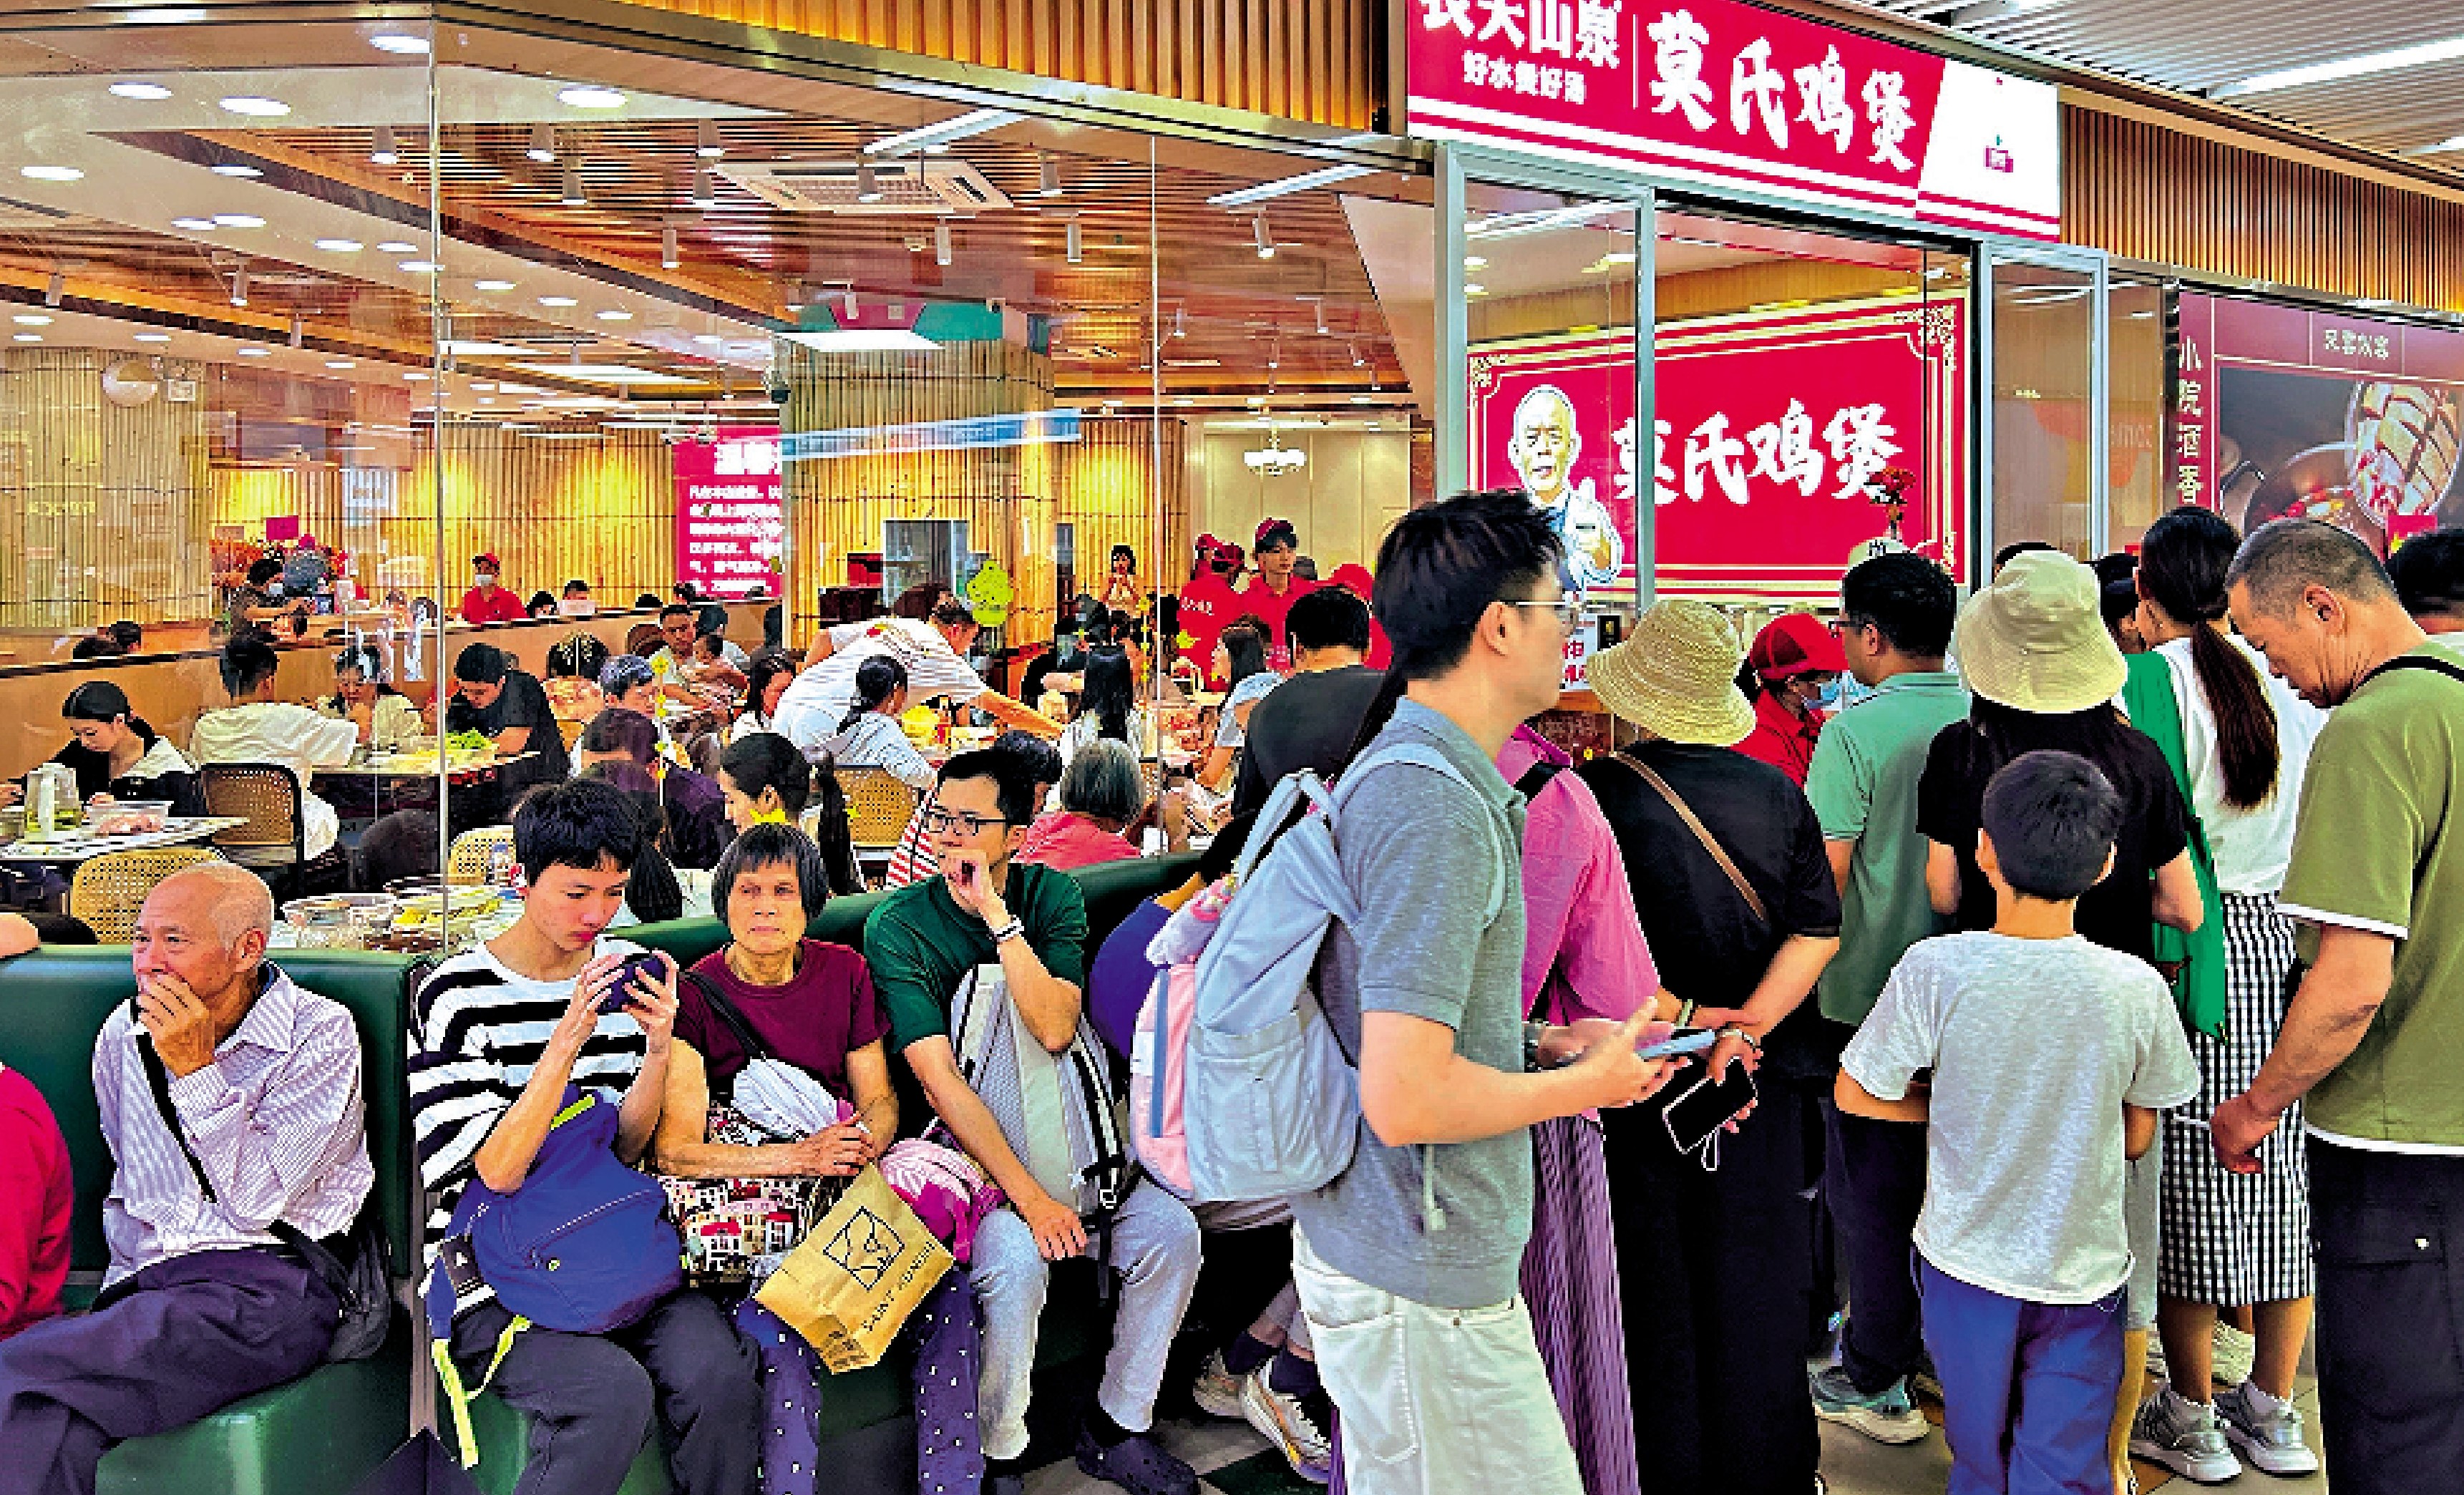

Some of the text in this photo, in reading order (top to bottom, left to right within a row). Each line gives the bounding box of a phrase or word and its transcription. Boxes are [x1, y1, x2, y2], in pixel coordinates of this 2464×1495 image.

[1646, 10, 1915, 173] 莫氏鸡煲
[1612, 398, 1904, 506] 莫氏鸡煲
